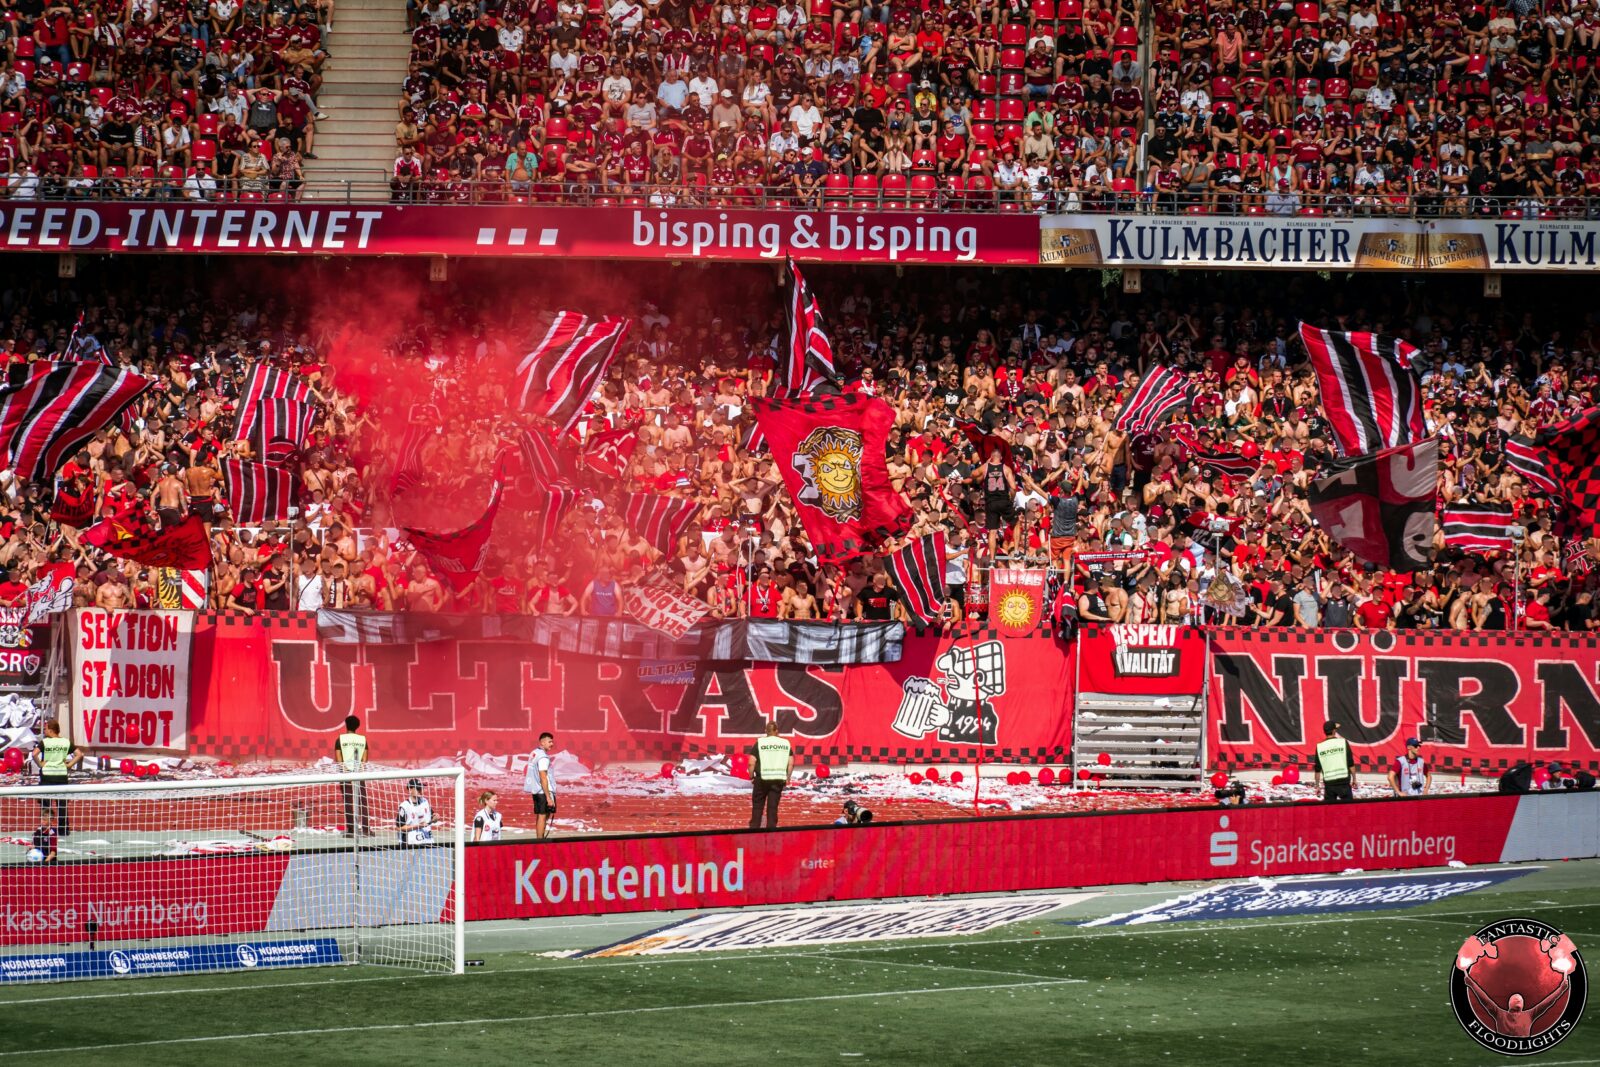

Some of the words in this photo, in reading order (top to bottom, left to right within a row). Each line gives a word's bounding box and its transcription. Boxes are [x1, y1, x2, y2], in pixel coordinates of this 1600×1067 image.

[0, 207, 383, 249] EED-INTERNET
[633, 210, 780, 258] bisping
[790, 214, 820, 249] &
[829, 215, 977, 261] bisping
[1107, 219, 1351, 262] KULMBACHER
[1040, 243, 1096, 263] KULMBACHER
[1361, 246, 1417, 267] KULMBACHER
[1427, 247, 1483, 268] KULMBACHER
[80, 611, 178, 652] SEKTION
[82, 660, 175, 699] STADION
[637, 661, 697, 678] ULTRAS
[271, 639, 844, 740] ULTRAS
[83, 709, 174, 748] VERBOT
[955, 714, 992, 734] 1994
[1250, 836, 1355, 870] Sparkasse
[1361, 830, 1456, 860] Nürnberg
[514, 847, 745, 905] Kontenund
[0, 903, 78, 932] kasse
[87, 896, 209, 929] Nürnberg
[1, 957, 66, 970] NÜRNBERGER
[132, 950, 191, 962] NÜRNBERGER
[257, 944, 317, 956] NÜRNBERGER
